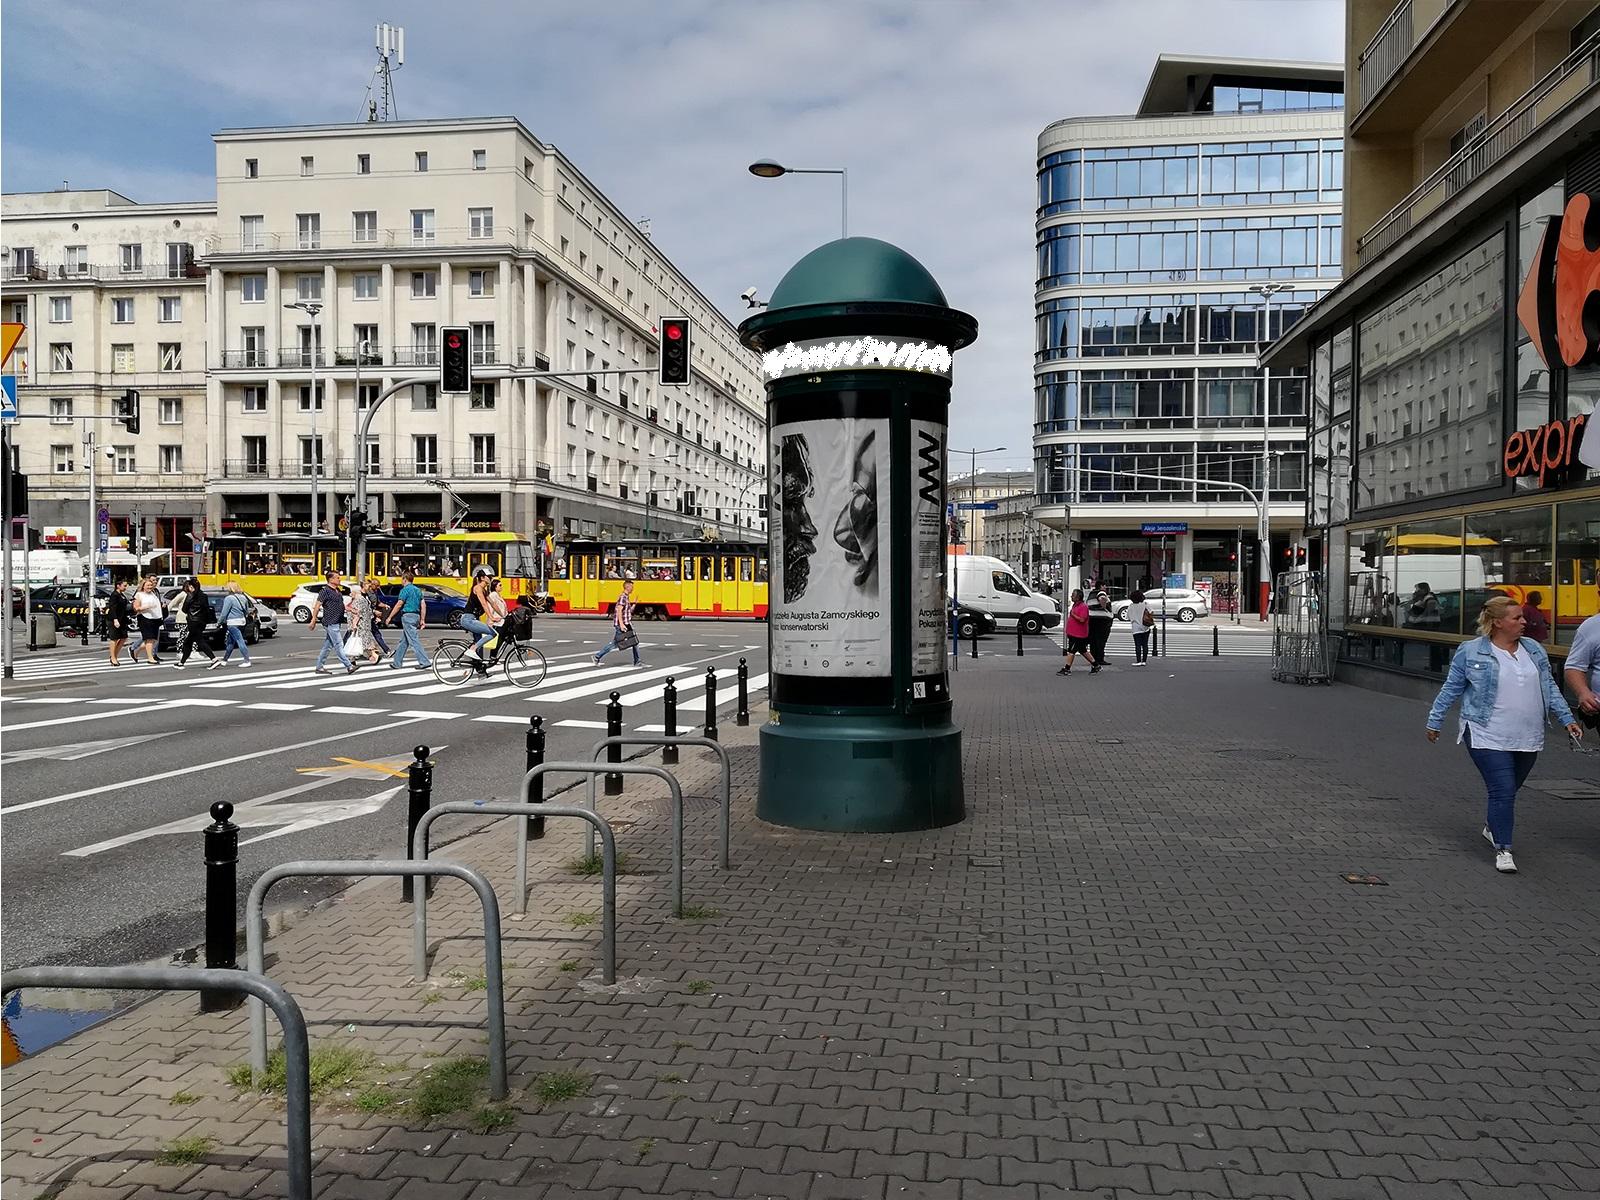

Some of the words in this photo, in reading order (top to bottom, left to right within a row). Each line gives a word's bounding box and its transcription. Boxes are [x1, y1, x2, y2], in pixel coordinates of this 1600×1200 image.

[1504, 414, 1585, 488] expr
[790, 611, 820, 621] Augusta
[820, 609, 880, 621] Zamoyskiego
